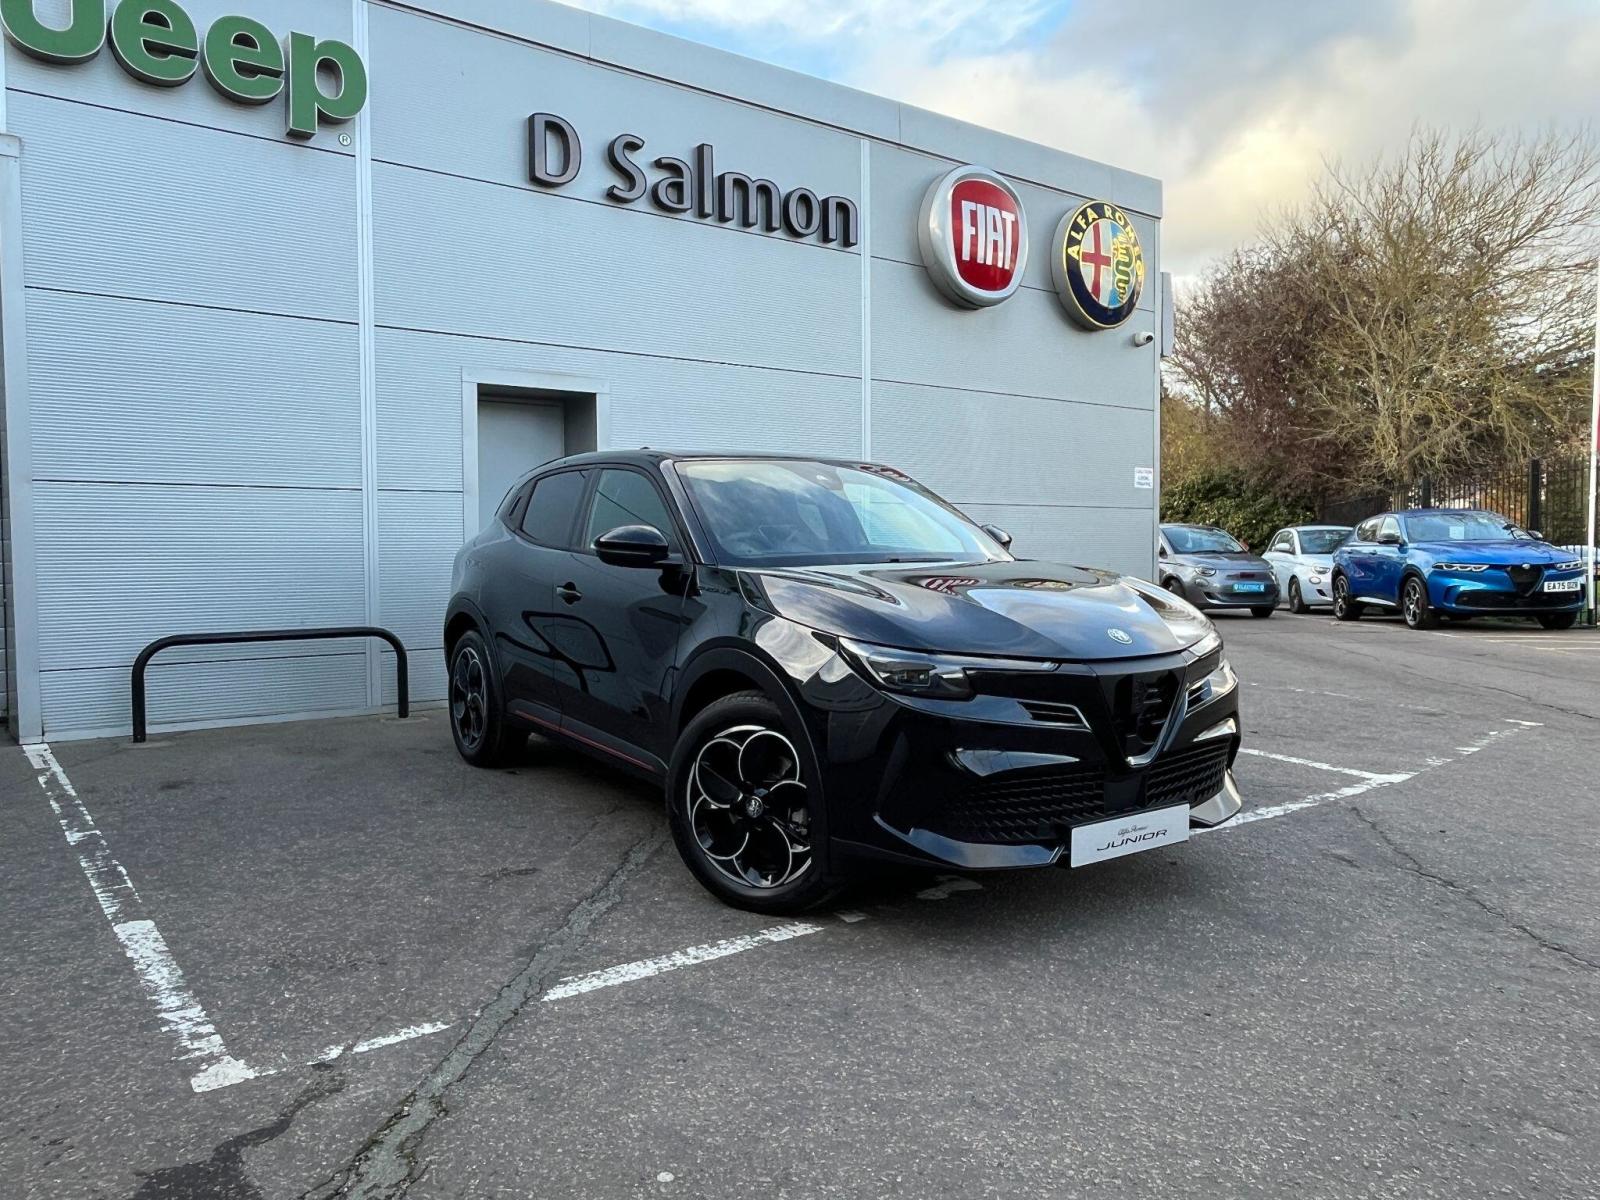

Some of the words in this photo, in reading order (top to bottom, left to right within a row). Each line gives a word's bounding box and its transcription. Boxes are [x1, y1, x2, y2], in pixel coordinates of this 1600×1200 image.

[527, 112, 582, 187] D
[605, 133, 858, 248] Salmon
[961, 199, 1016, 271] FIAT
[1066, 205, 1101, 261] ALFA
[1096, 829, 1168, 851] JUNIOR
